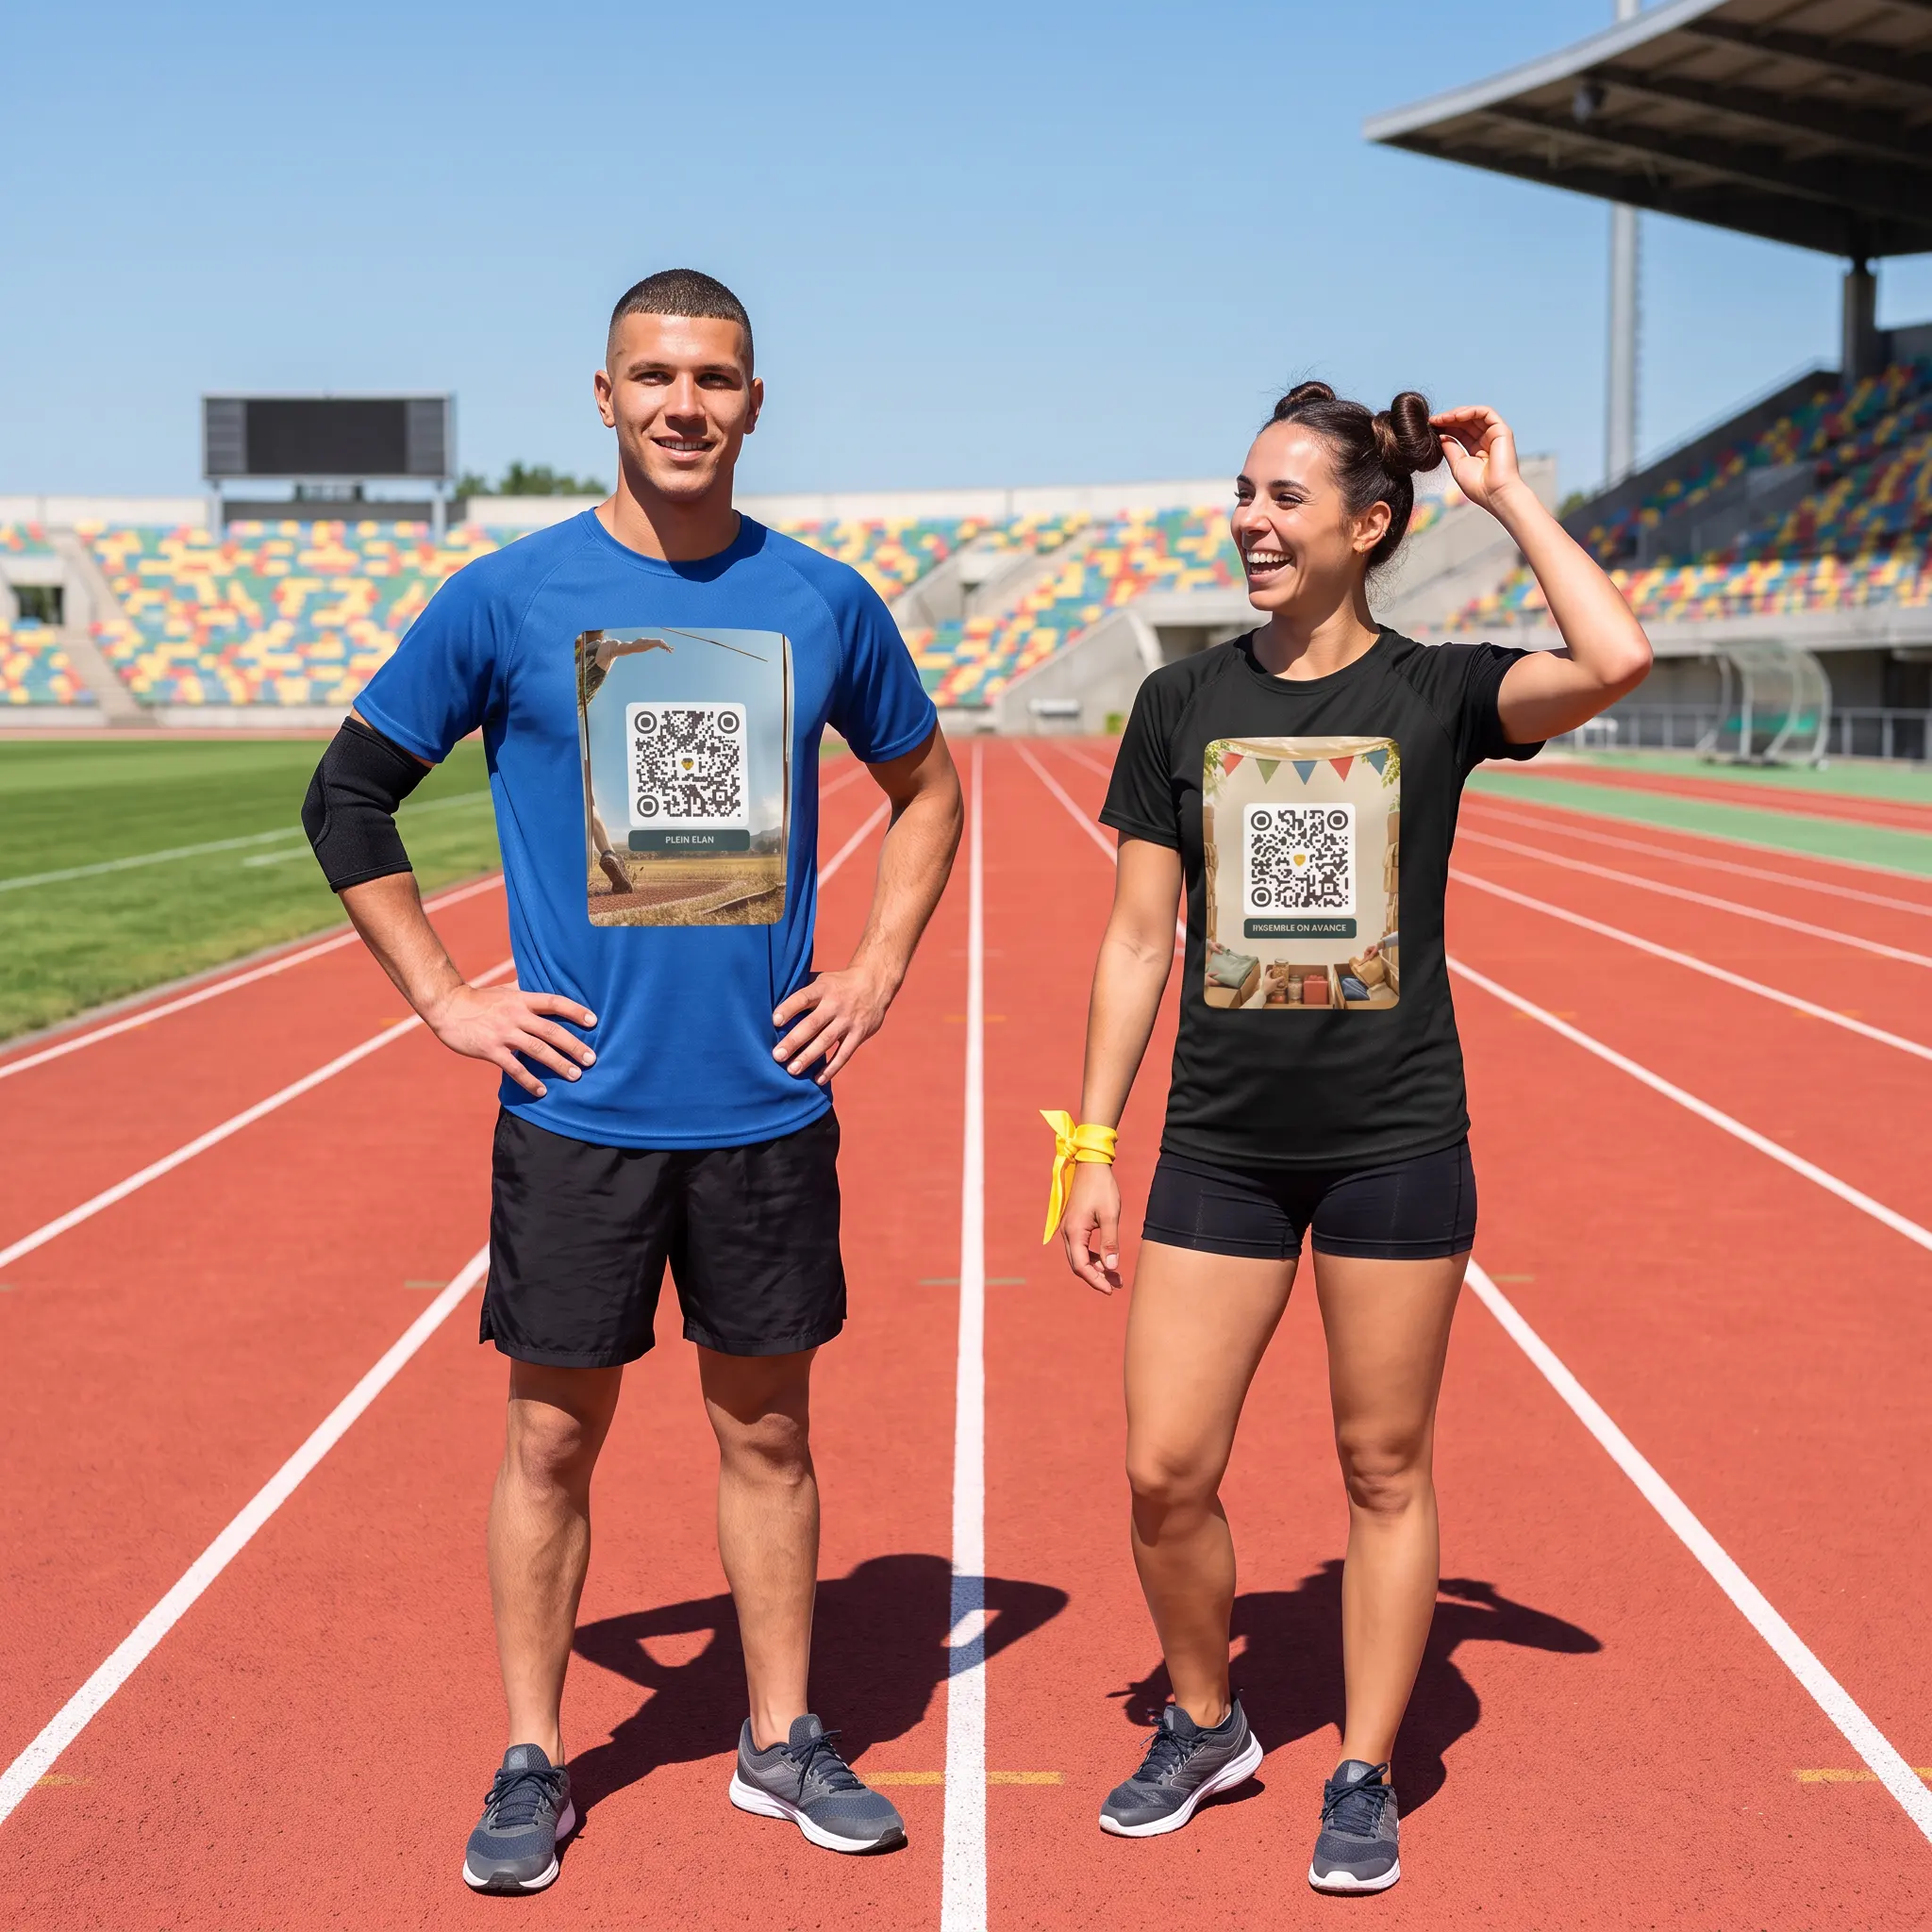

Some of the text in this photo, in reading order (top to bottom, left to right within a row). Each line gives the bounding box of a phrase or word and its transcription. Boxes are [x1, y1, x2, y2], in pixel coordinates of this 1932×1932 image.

[665, 836, 714, 844] PLEIN ELAN
[1297, 924, 1310, 932] ON
[1311, 924, 1347, 932] AVANCE
